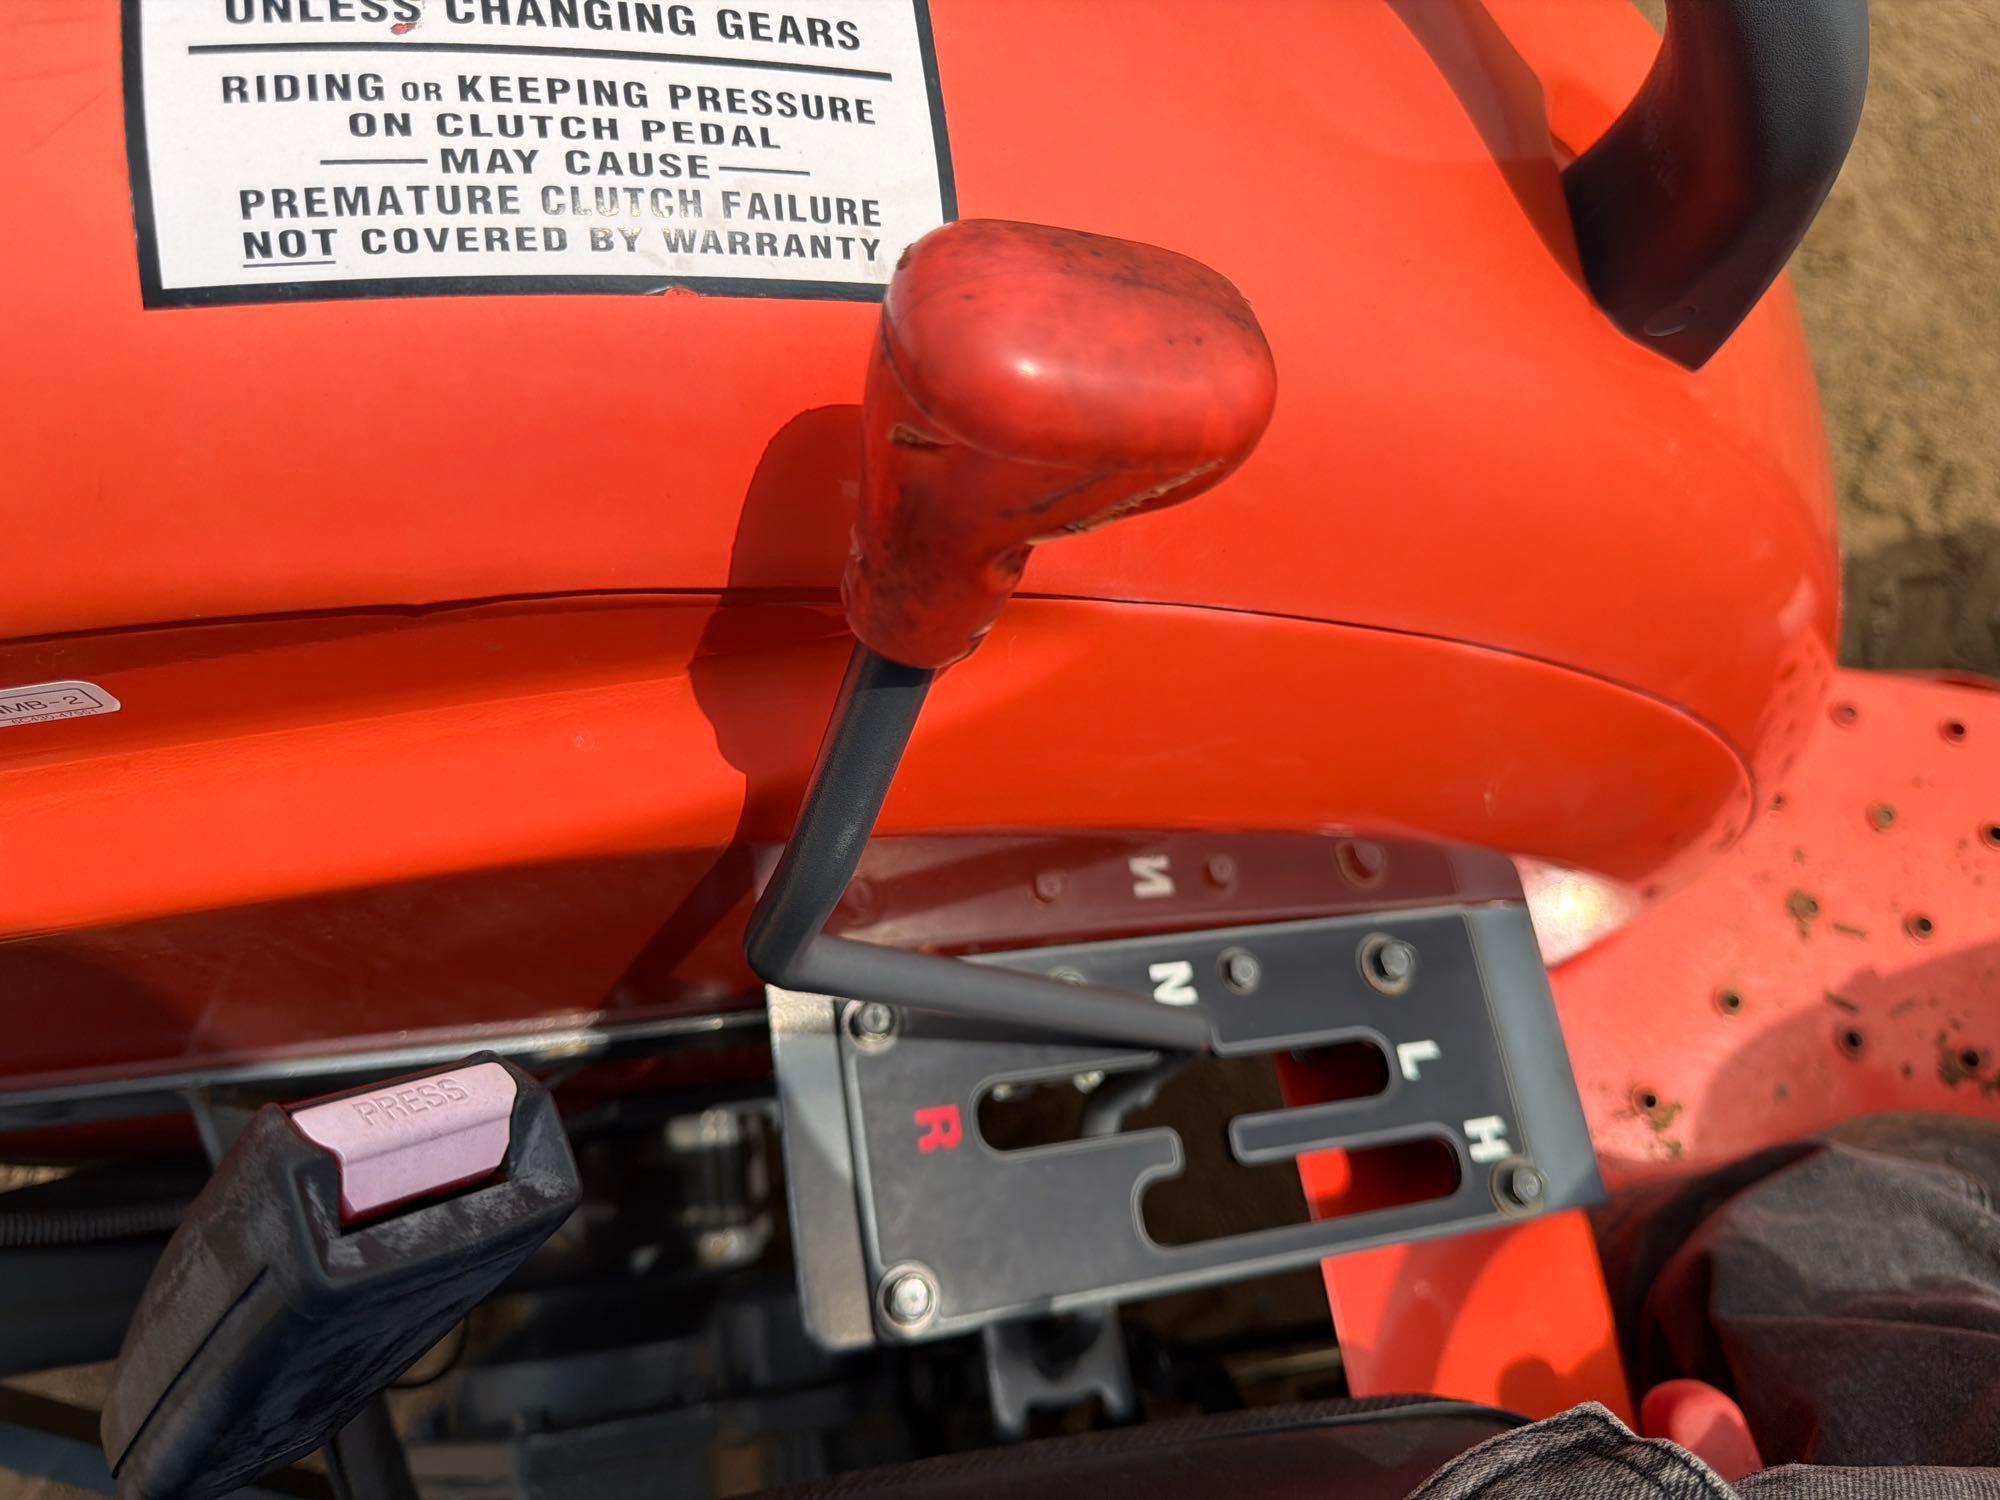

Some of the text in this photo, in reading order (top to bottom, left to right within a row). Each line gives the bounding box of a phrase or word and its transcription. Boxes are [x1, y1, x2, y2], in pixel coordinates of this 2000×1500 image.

[225, 0, 861, 51] UNLESS CHANGING GEARS
[222, 73, 876, 125] RIDING OR KEEPING PRESSURE
[349, 112, 781, 150] ON CLUTCH PEDAL
[440, 148, 710, 179] MAY CAUSE
[239, 185, 882, 227] PREMATURE CLUTCH FAILURE
[243, 226, 881, 262] NOT COVERED BY WARRANTY
[1148, 960, 1200, 1006] N
[1397, 1040, 1442, 1081] L
[351, 1078, 469, 1126] PRESS
[914, 1104, 963, 1153] R
[1463, 1115, 1512, 1163] H
